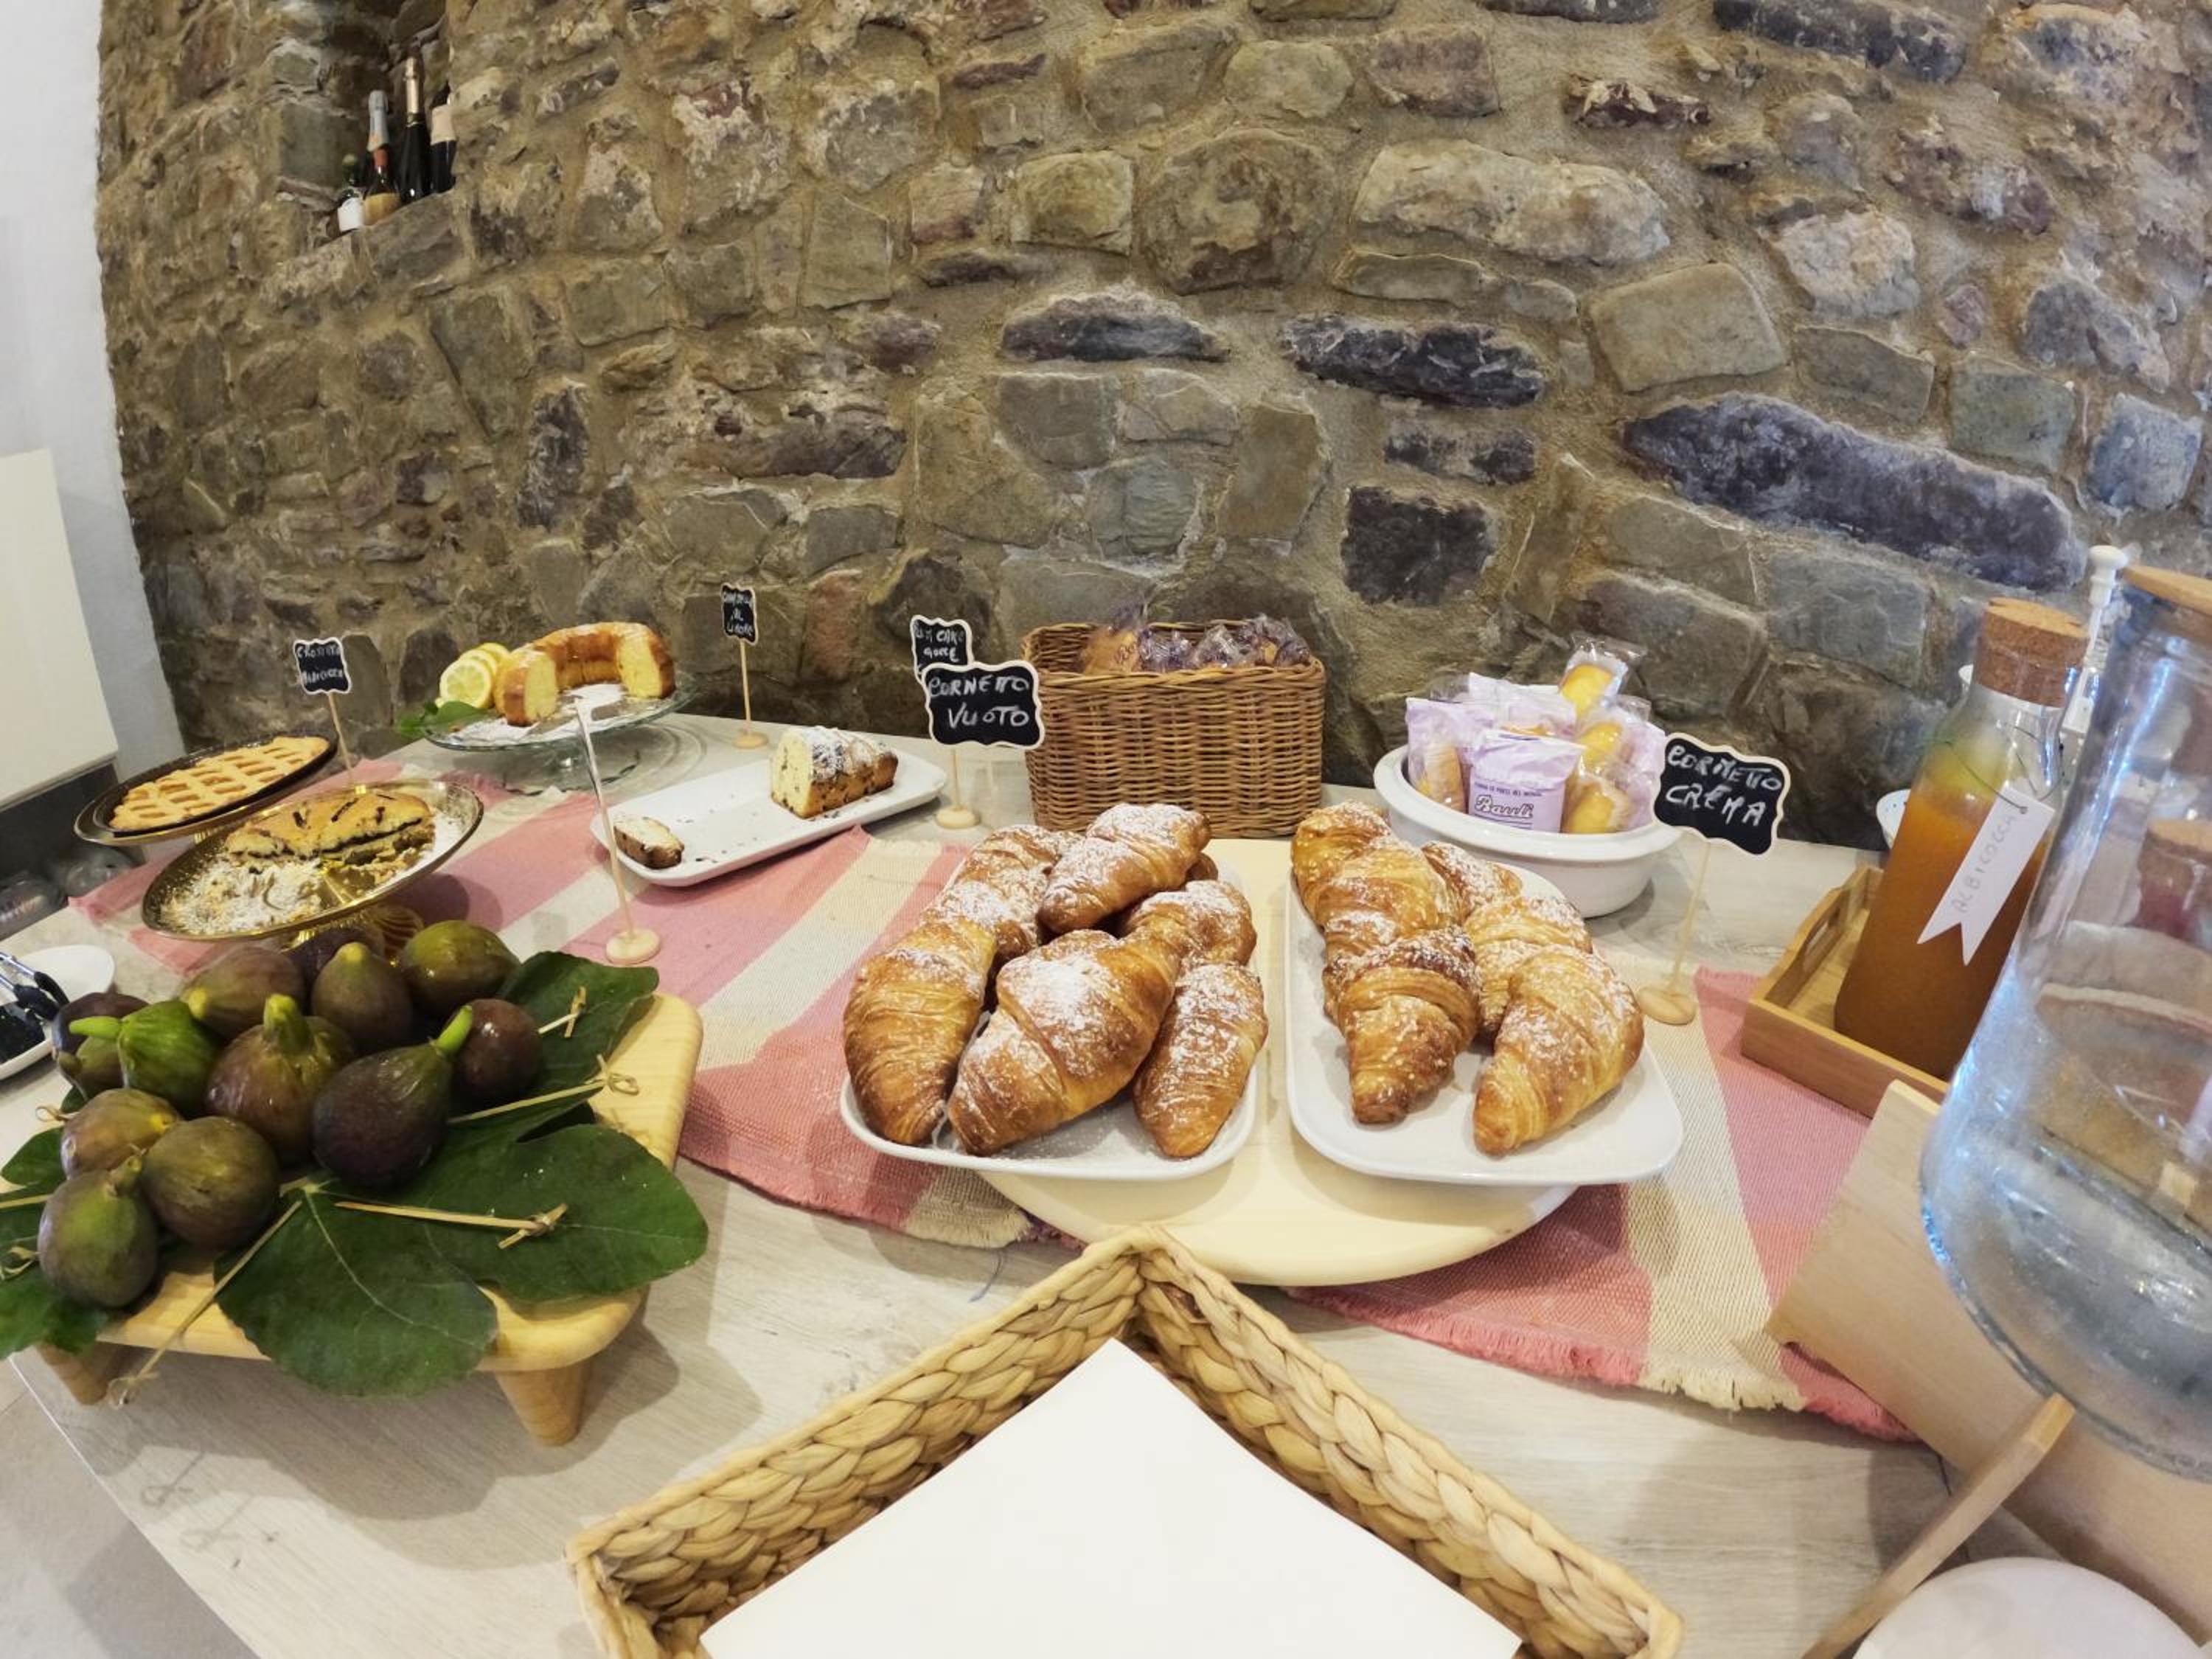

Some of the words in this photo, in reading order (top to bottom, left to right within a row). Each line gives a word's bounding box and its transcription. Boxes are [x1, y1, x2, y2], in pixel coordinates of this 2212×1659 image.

[928, 674, 1030, 698] CORNETTO
[947, 702, 1030, 730] VUOTO
[1667, 745, 1783, 791] CORNETTO
[1474, 794, 1534, 819] Bauli
[1665, 782, 1767, 827] CREMA
